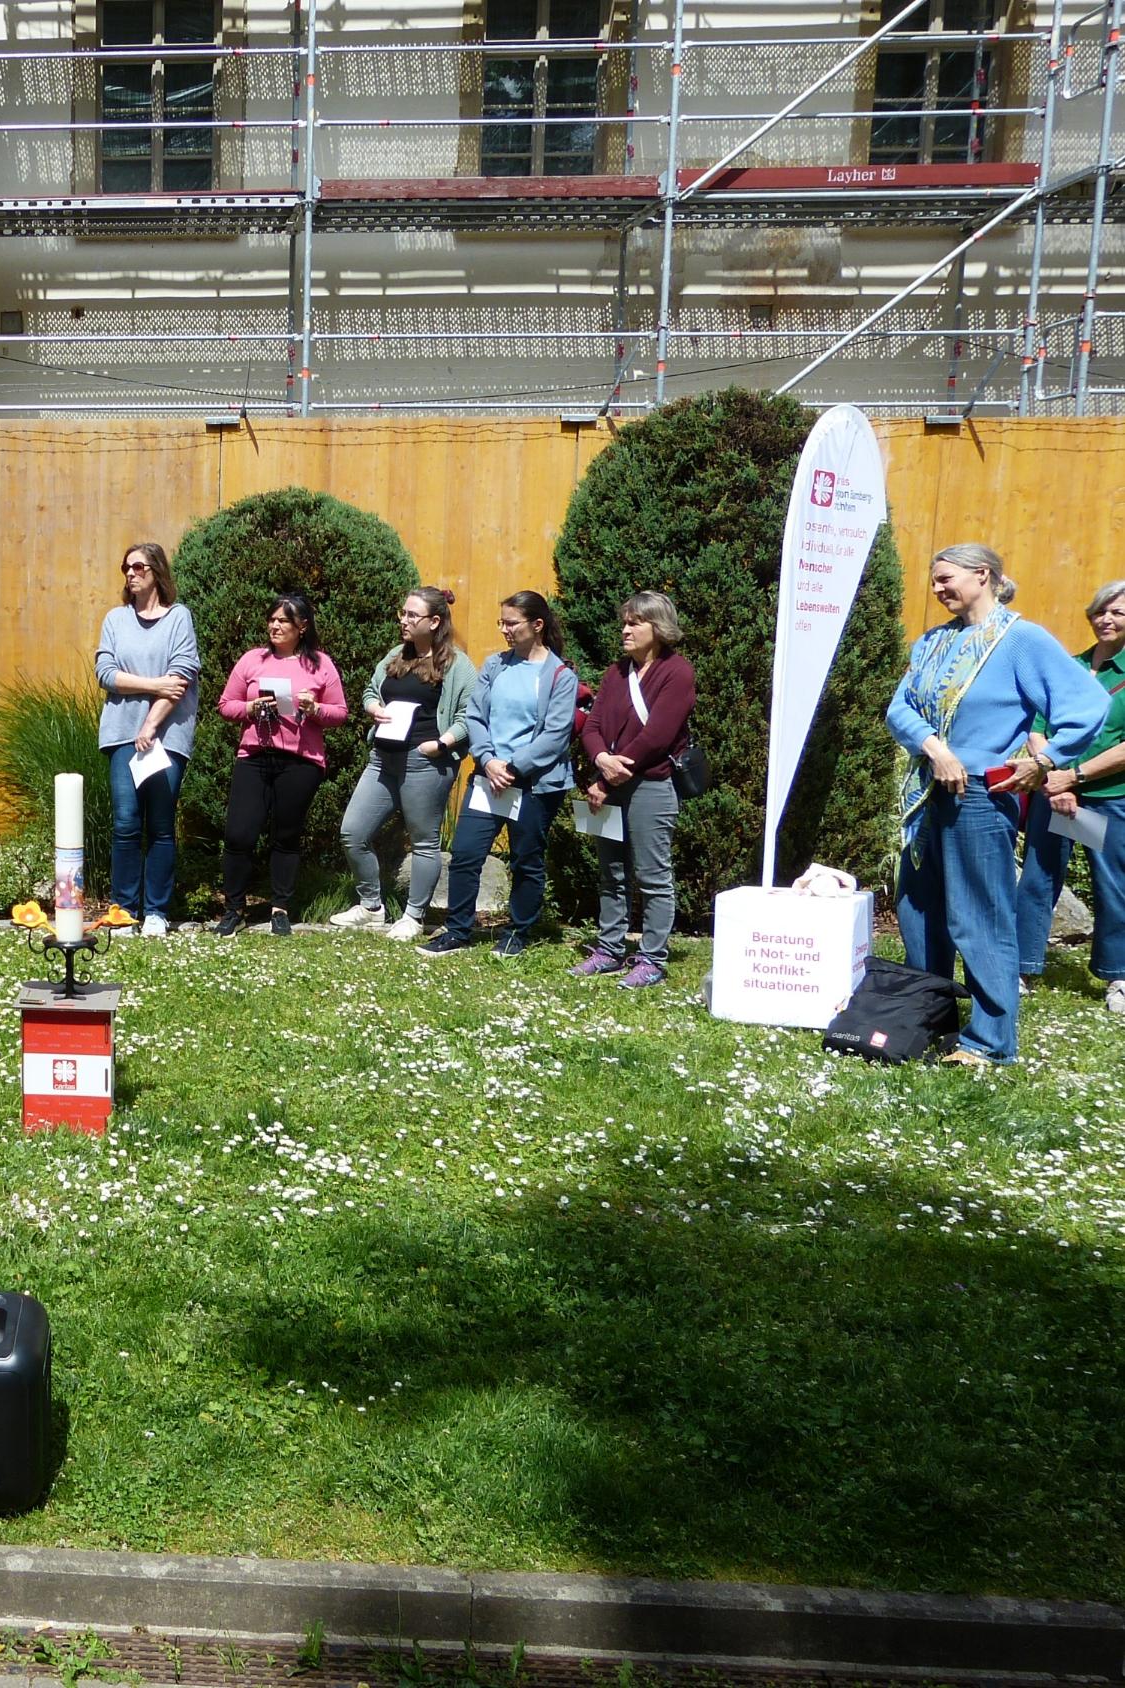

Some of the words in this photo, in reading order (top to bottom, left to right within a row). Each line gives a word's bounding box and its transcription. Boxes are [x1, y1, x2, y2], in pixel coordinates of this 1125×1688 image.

[827, 168, 876, 183] Layher
[752, 932, 814, 947] Beratung
[745, 947, 756, 957] in
[761, 948, 791, 959] Not-
[794, 951, 820, 961] und
[753, 962, 811, 976] Konflikt-
[744, 978, 820, 993] situationen
